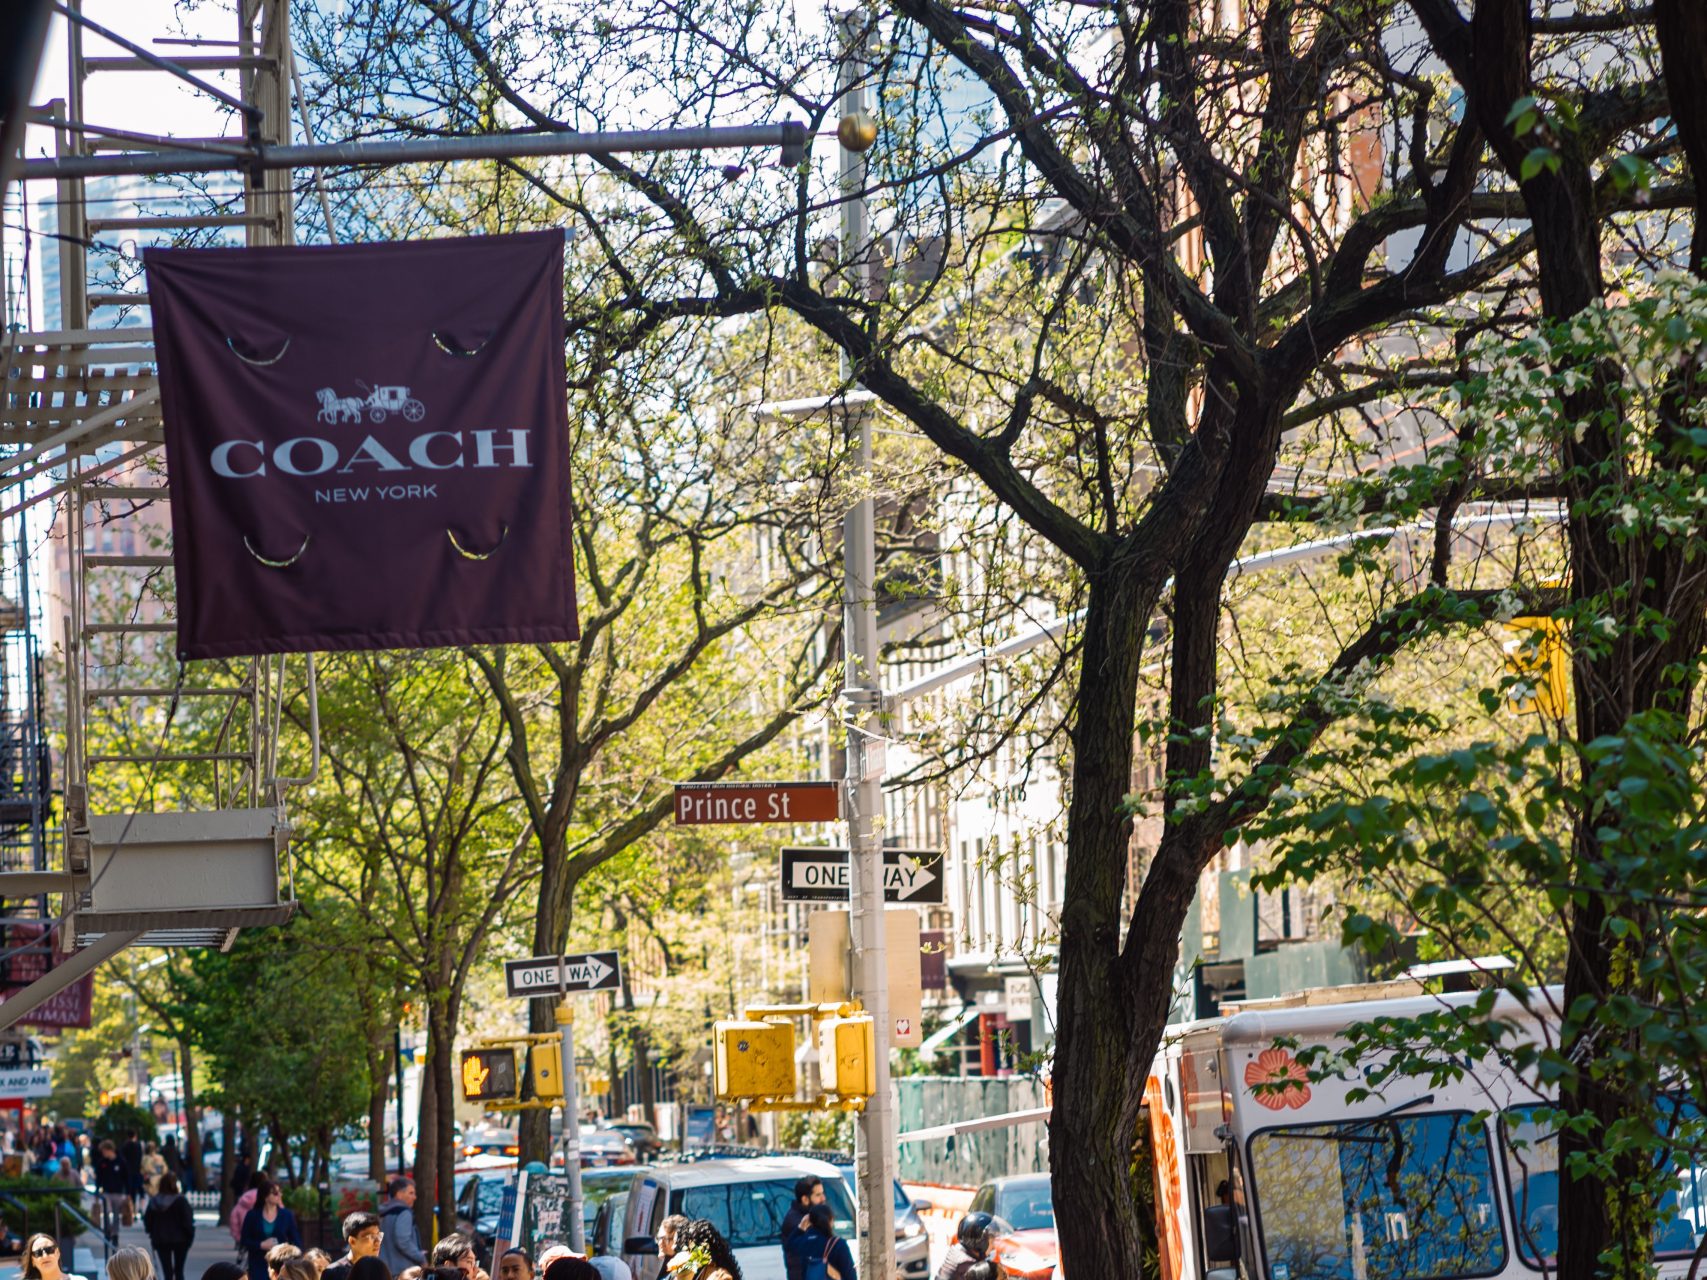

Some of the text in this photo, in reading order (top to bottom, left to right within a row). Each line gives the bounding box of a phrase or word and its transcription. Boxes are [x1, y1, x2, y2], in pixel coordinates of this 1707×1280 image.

[209, 428, 535, 478] COACH
[315, 484, 438, 503] NEW YORK
[680, 792, 791, 821] Prince St
[805, 865, 850, 886] ONE
[522, 965, 602, 985] ONE WAY
